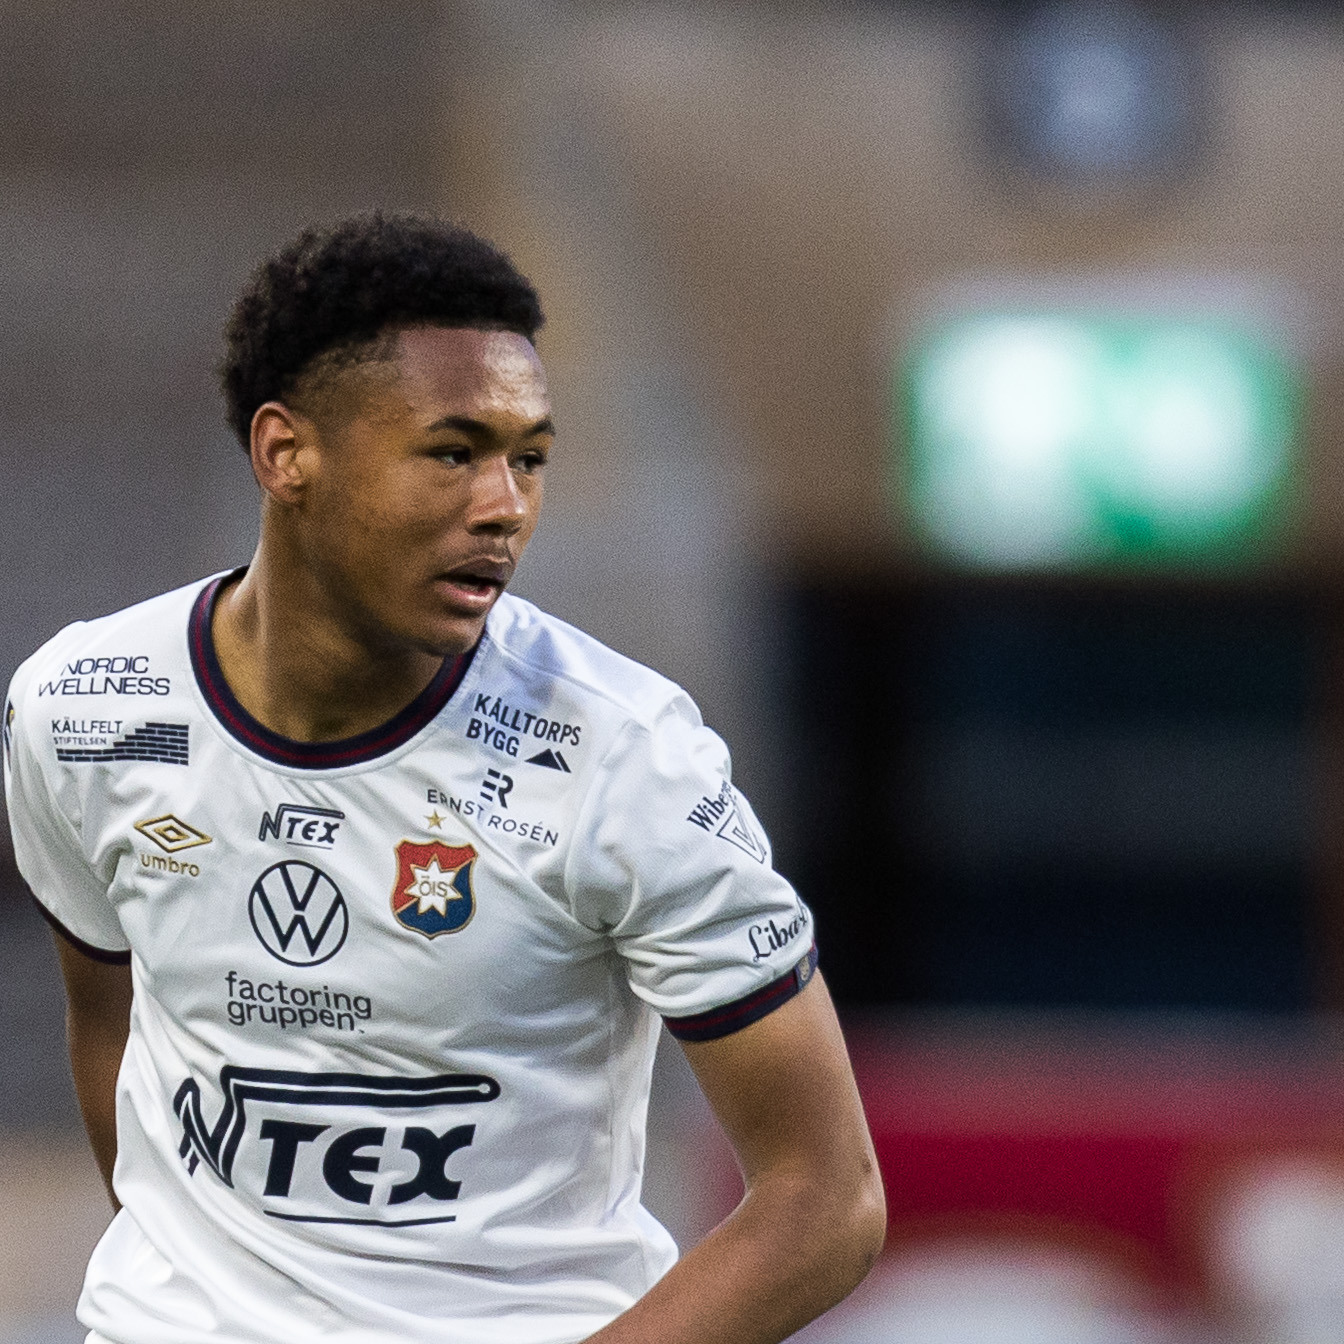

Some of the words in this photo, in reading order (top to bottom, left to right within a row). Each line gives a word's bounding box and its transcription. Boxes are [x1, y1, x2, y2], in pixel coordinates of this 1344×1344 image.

[60, 656, 149, 676] NORDIC
[38, 677, 171, 697] WELLNESS
[51, 716, 123, 735] KÄLLFELT
[53, 736, 108, 746] STIFTELSEN
[465, 717, 521, 758] BYGG
[426, 788, 486, 825] ERNST
[487, 814, 560, 847] ROSÉN
[140, 852, 202, 878] umbro
[225, 970, 372, 1020] factoring
